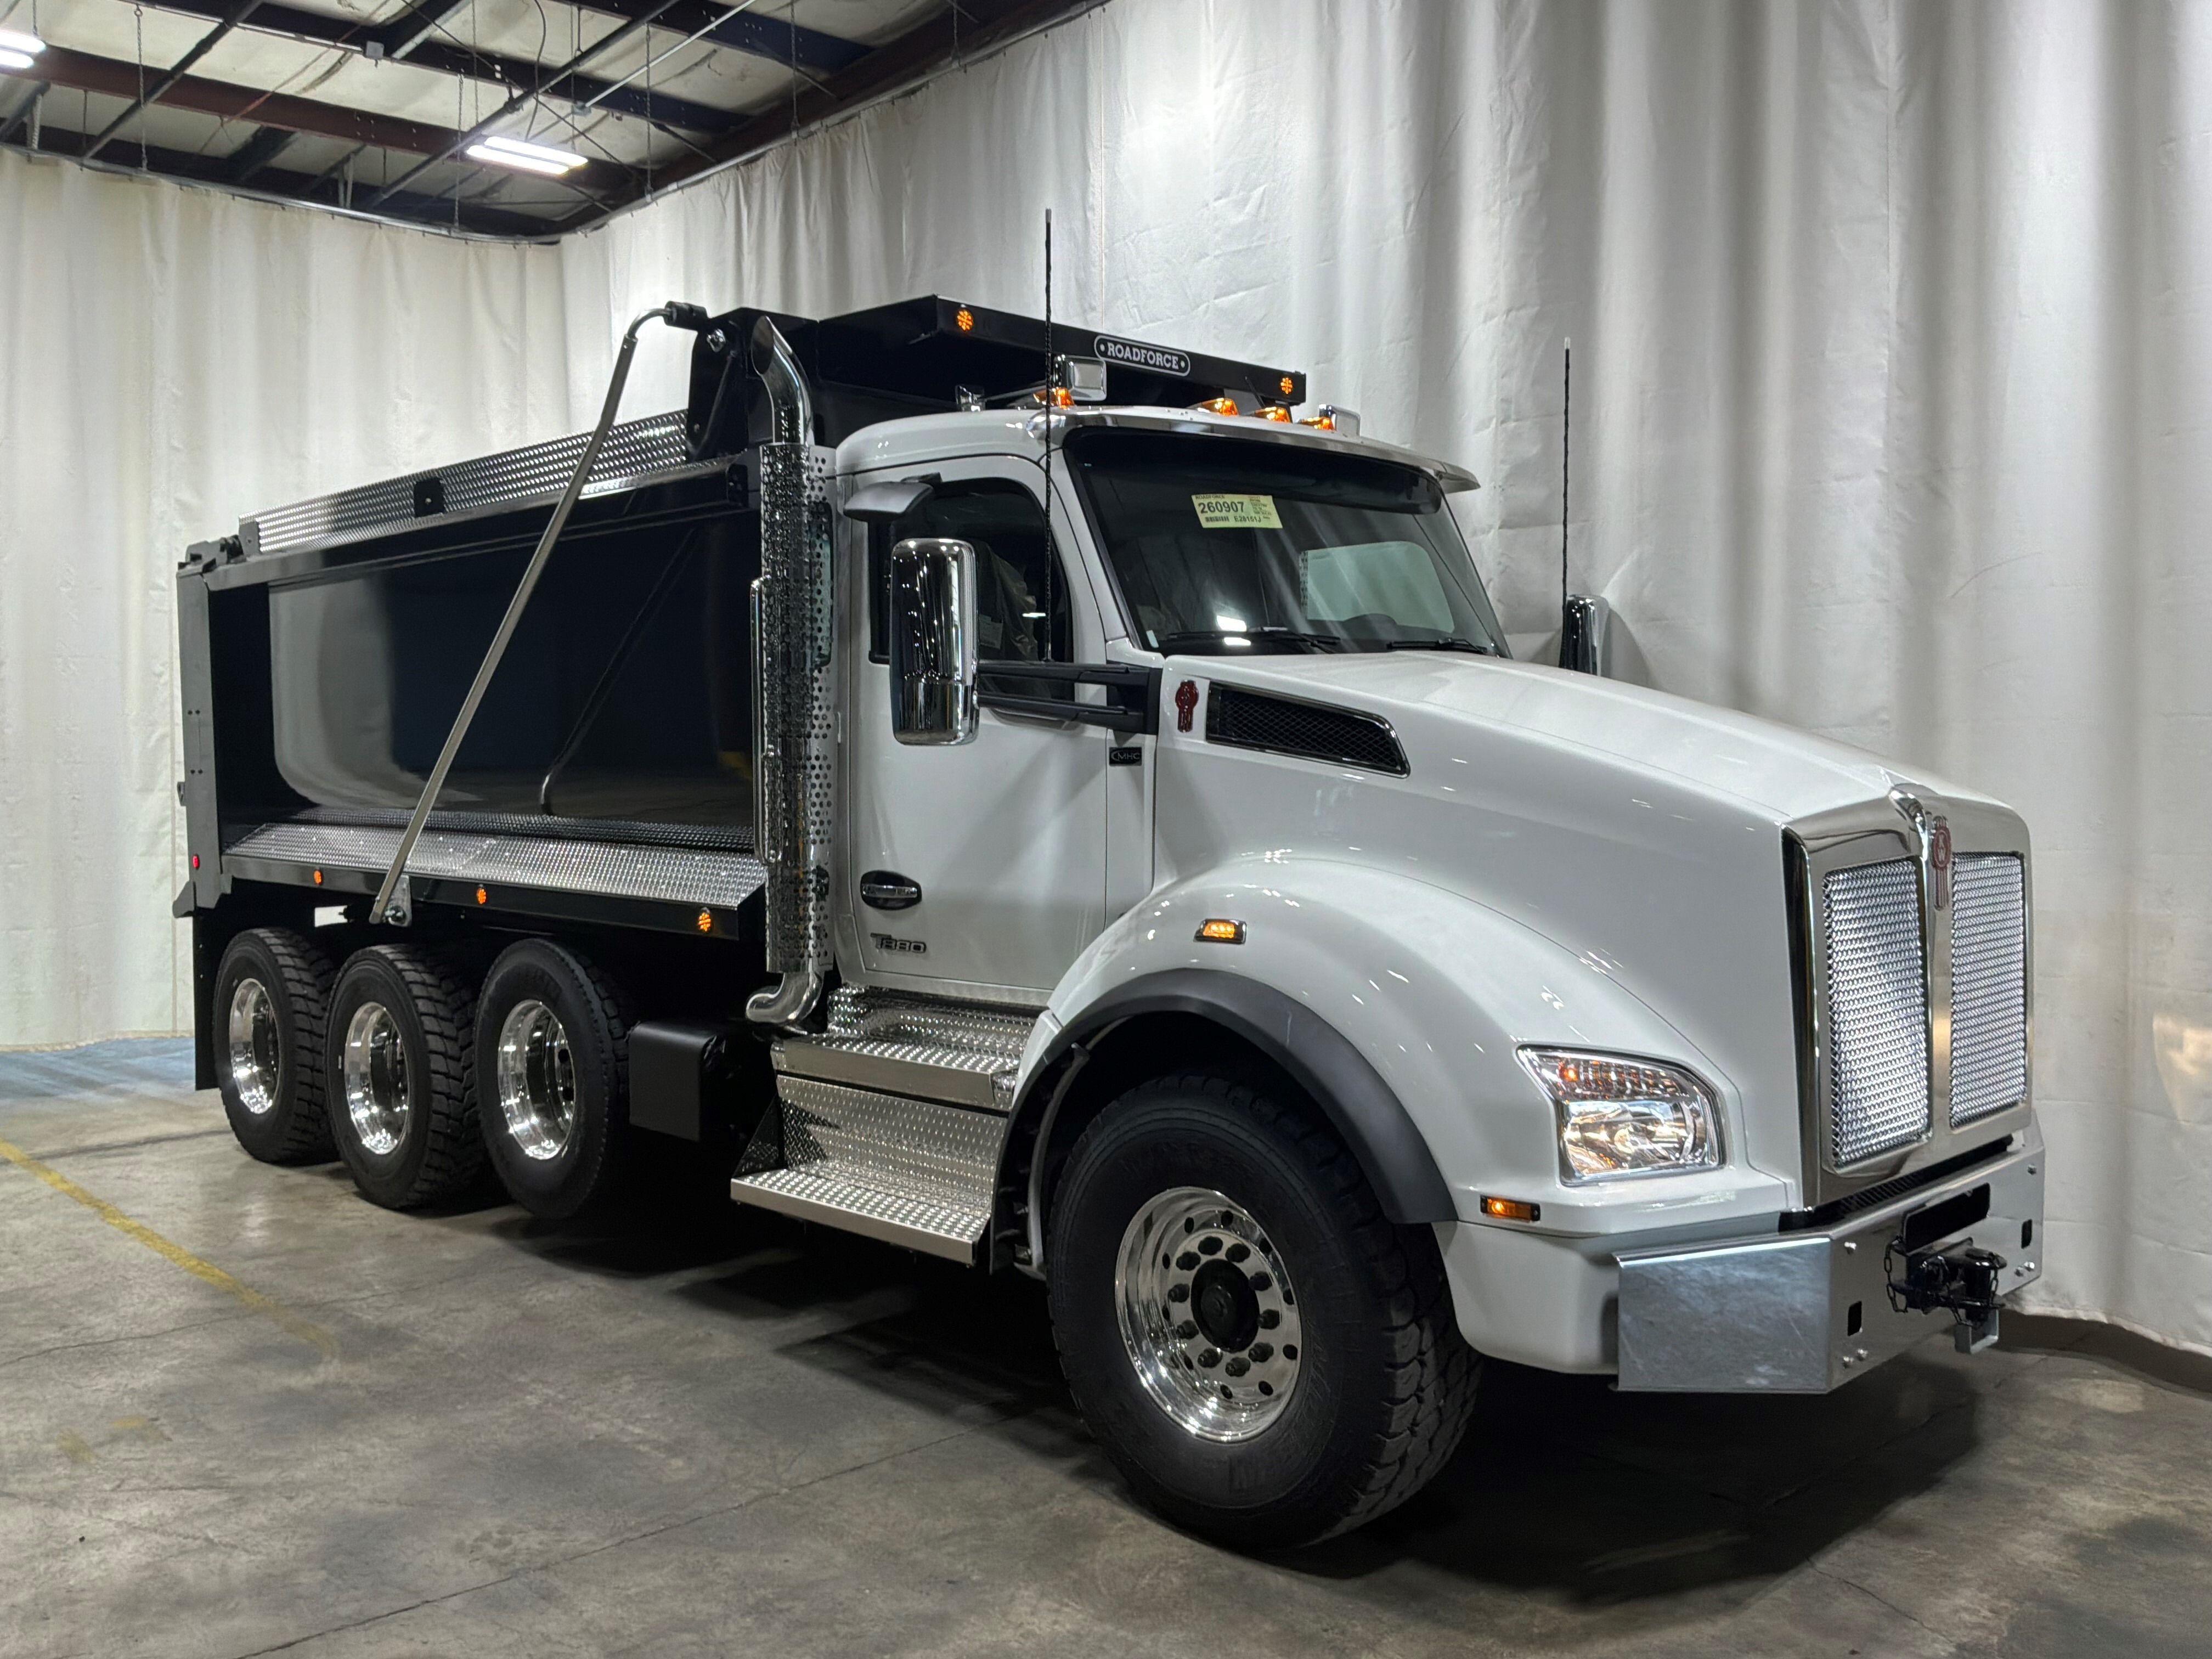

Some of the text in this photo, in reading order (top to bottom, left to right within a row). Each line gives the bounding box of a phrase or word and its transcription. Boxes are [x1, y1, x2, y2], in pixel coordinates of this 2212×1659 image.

[1107, 342, 1179, 369] ROADFORCE
[1198, 501, 1244, 514] 260907
[1117, 752, 1141, 760] MHC
[870, 932, 927, 953] T880
